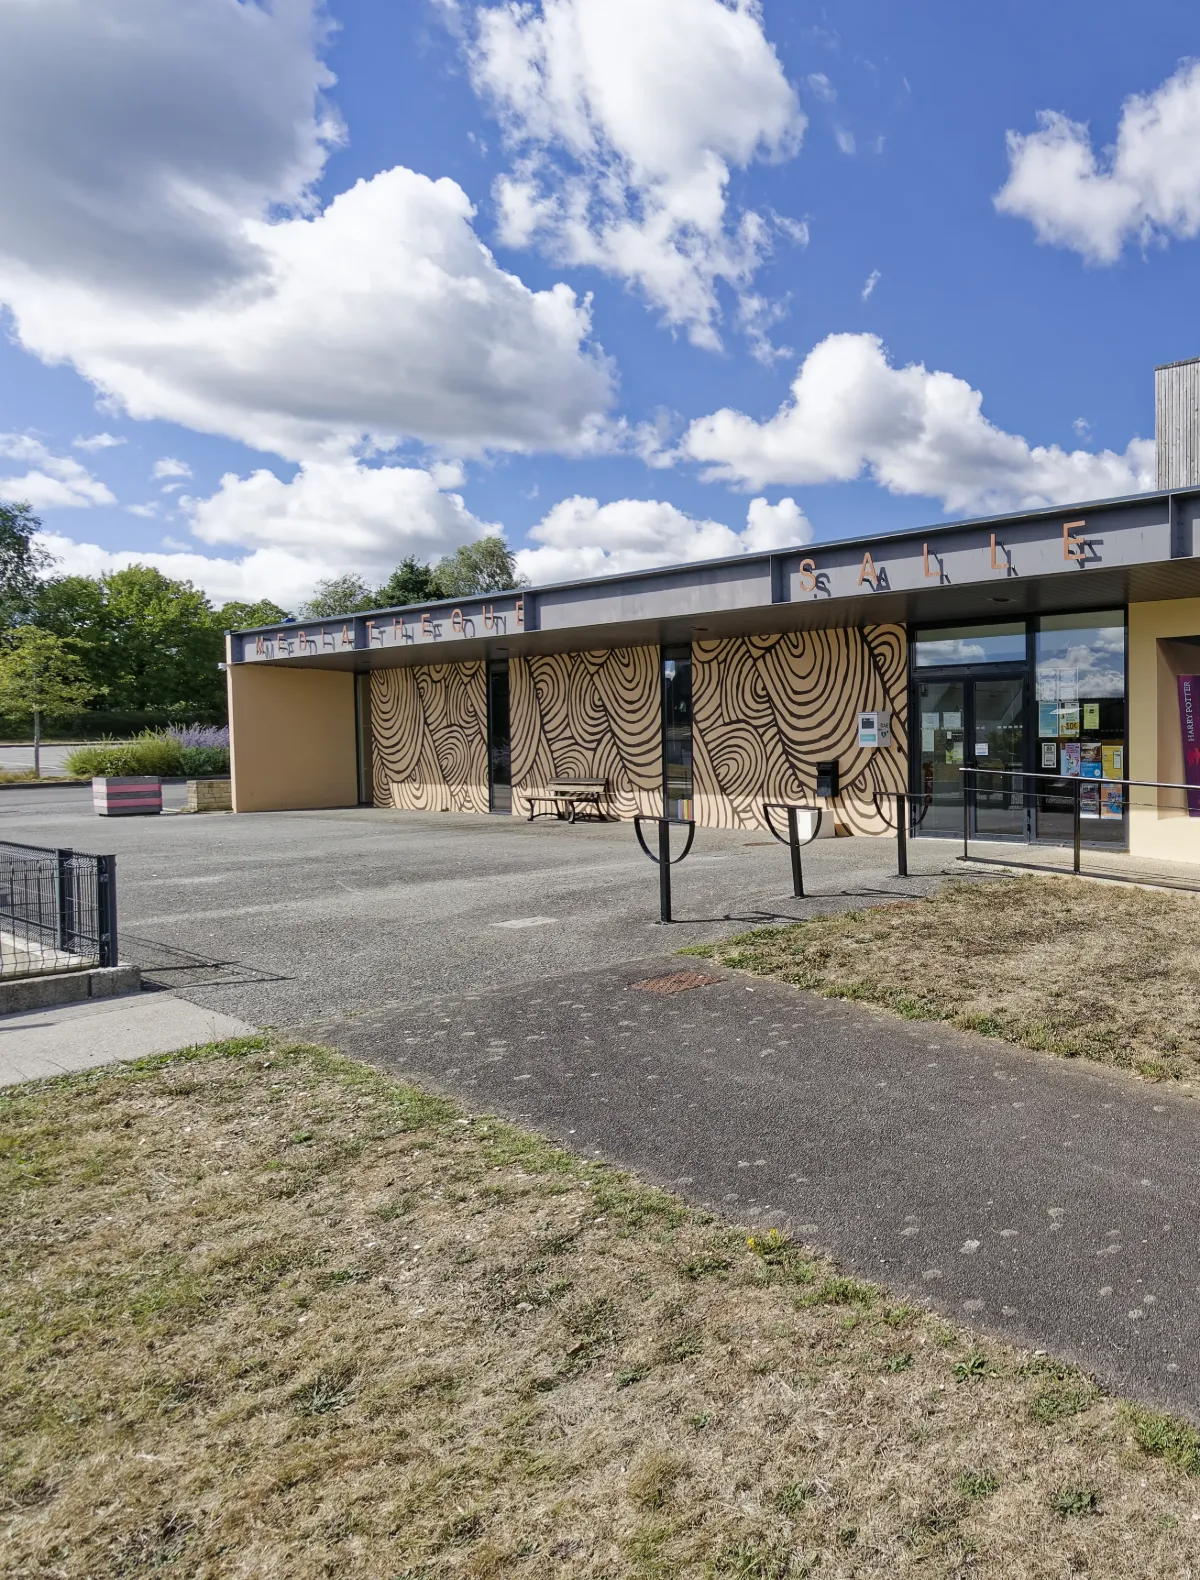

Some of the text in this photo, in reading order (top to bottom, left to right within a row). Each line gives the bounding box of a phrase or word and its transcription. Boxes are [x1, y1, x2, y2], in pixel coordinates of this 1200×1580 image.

[255, 600, 524, 656] MEDIATHEQUE
[800, 520, 1086, 592] SALLE
[1184, 681, 1195, 742] HARRY POTTER
